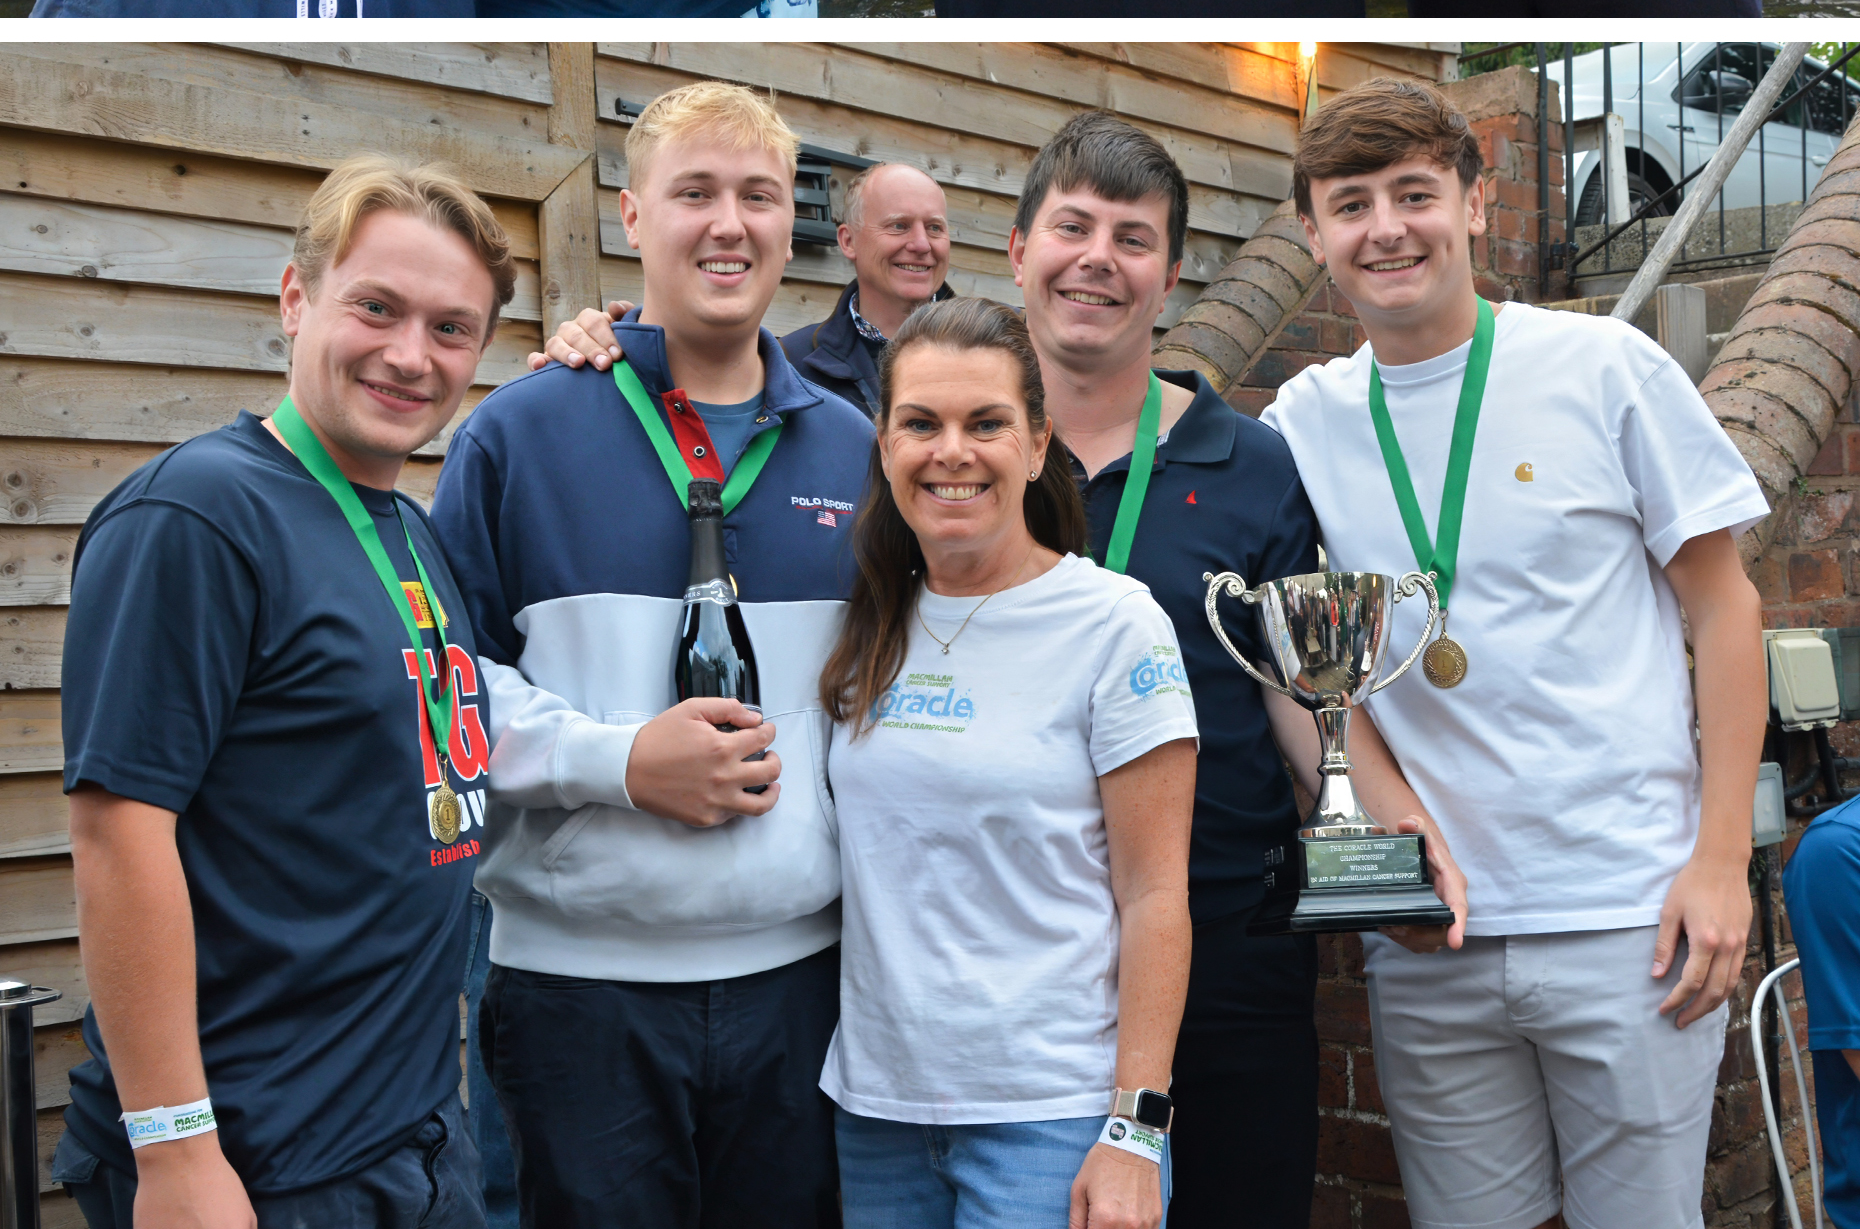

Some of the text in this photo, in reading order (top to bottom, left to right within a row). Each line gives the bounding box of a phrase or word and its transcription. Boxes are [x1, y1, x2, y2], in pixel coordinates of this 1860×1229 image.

[791, 496, 854, 511] POLO SPORT
[907, 673, 953, 682] MACMILLAN
[401, 643, 489, 789] TG
[881, 721, 965, 733] WORLD CHAMPIONSHIP
[1340, 854, 1386, 862] CHAMPIONSHIP
[176, 1122, 201, 1133] CANCER
